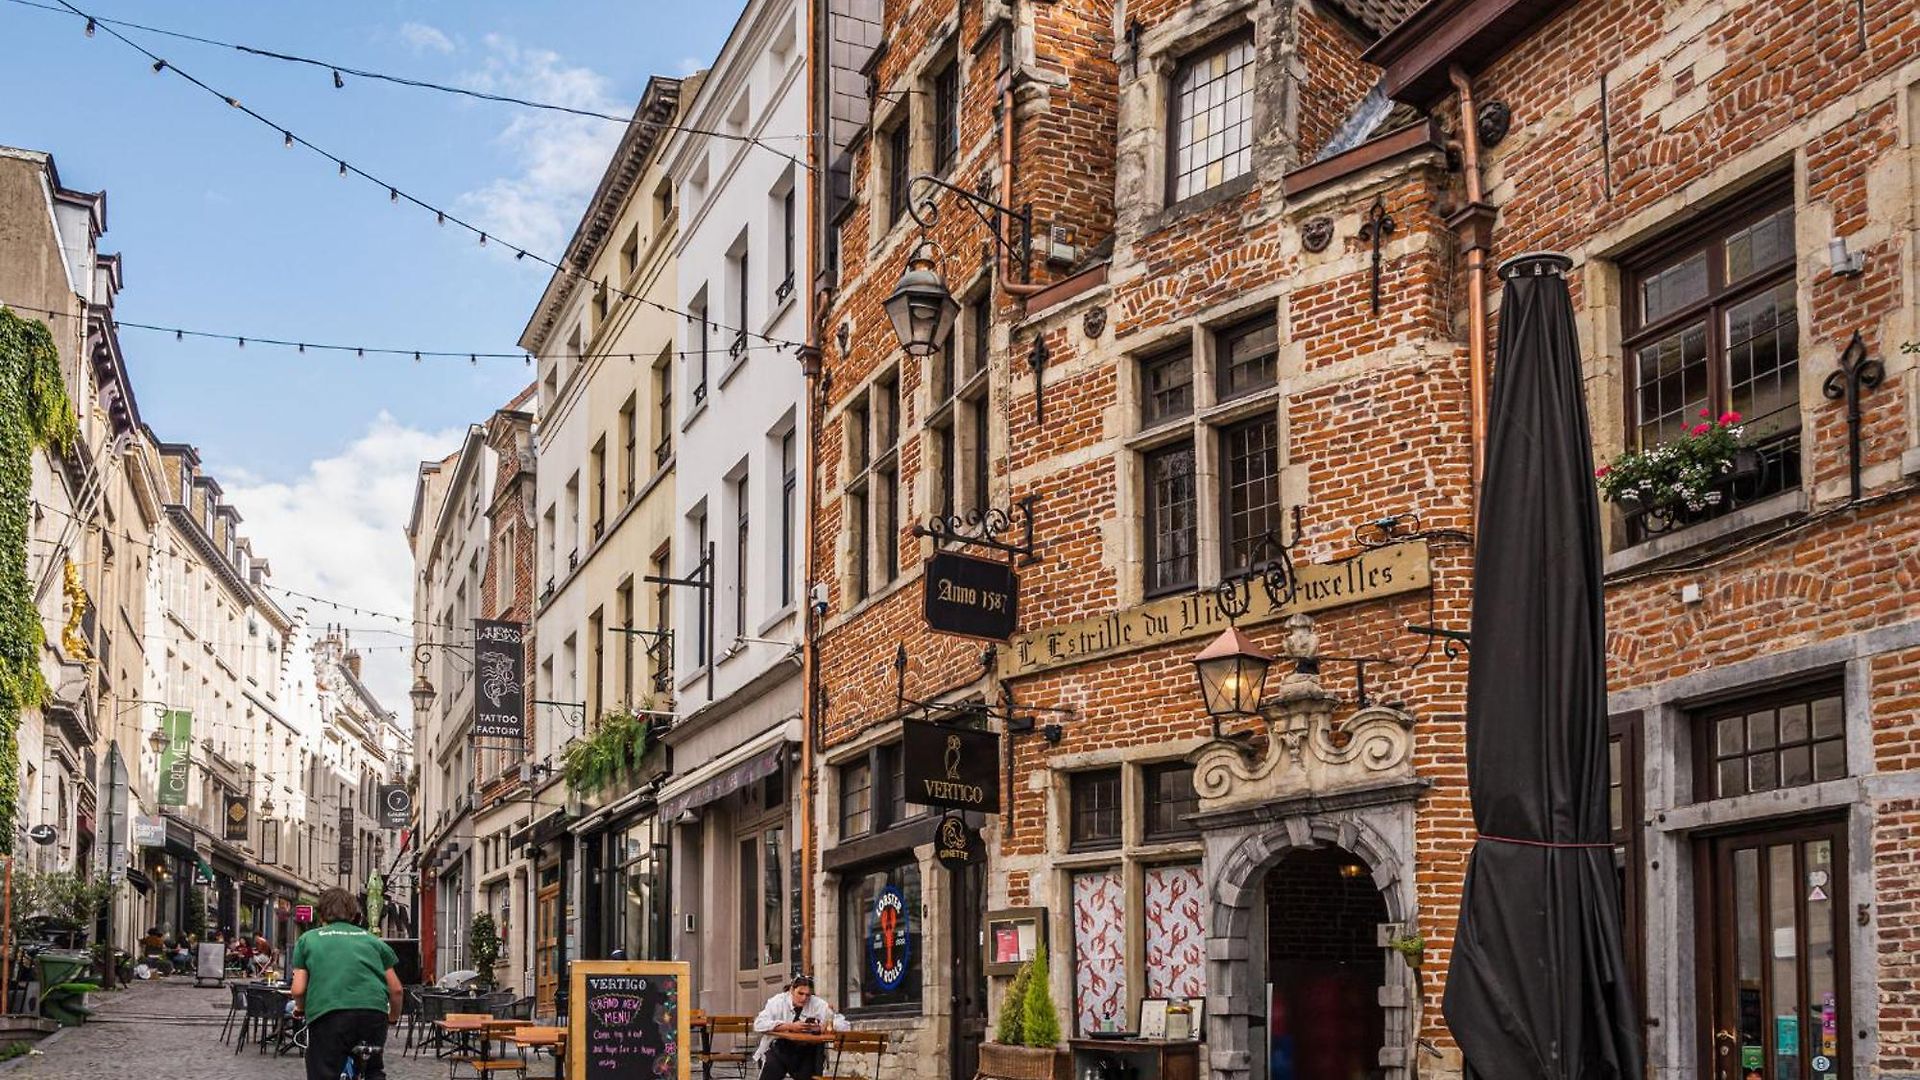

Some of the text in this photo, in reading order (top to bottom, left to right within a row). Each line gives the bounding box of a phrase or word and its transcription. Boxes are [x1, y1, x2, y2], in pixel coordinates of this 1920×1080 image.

[938, 579, 1008, 615] Anno 1587
[1144, 612, 1168, 636] du
[476, 725, 520, 735] FACTORY
[479, 713, 518, 724] TATTOO
[923, 779, 983, 803] VERTIGO
[875, 893, 902, 918] LOBSTER
[1857, 903, 1870, 926] 5
[589, 978, 647, 990] VERTIGO
[604, 1010, 631, 1024] MENU
